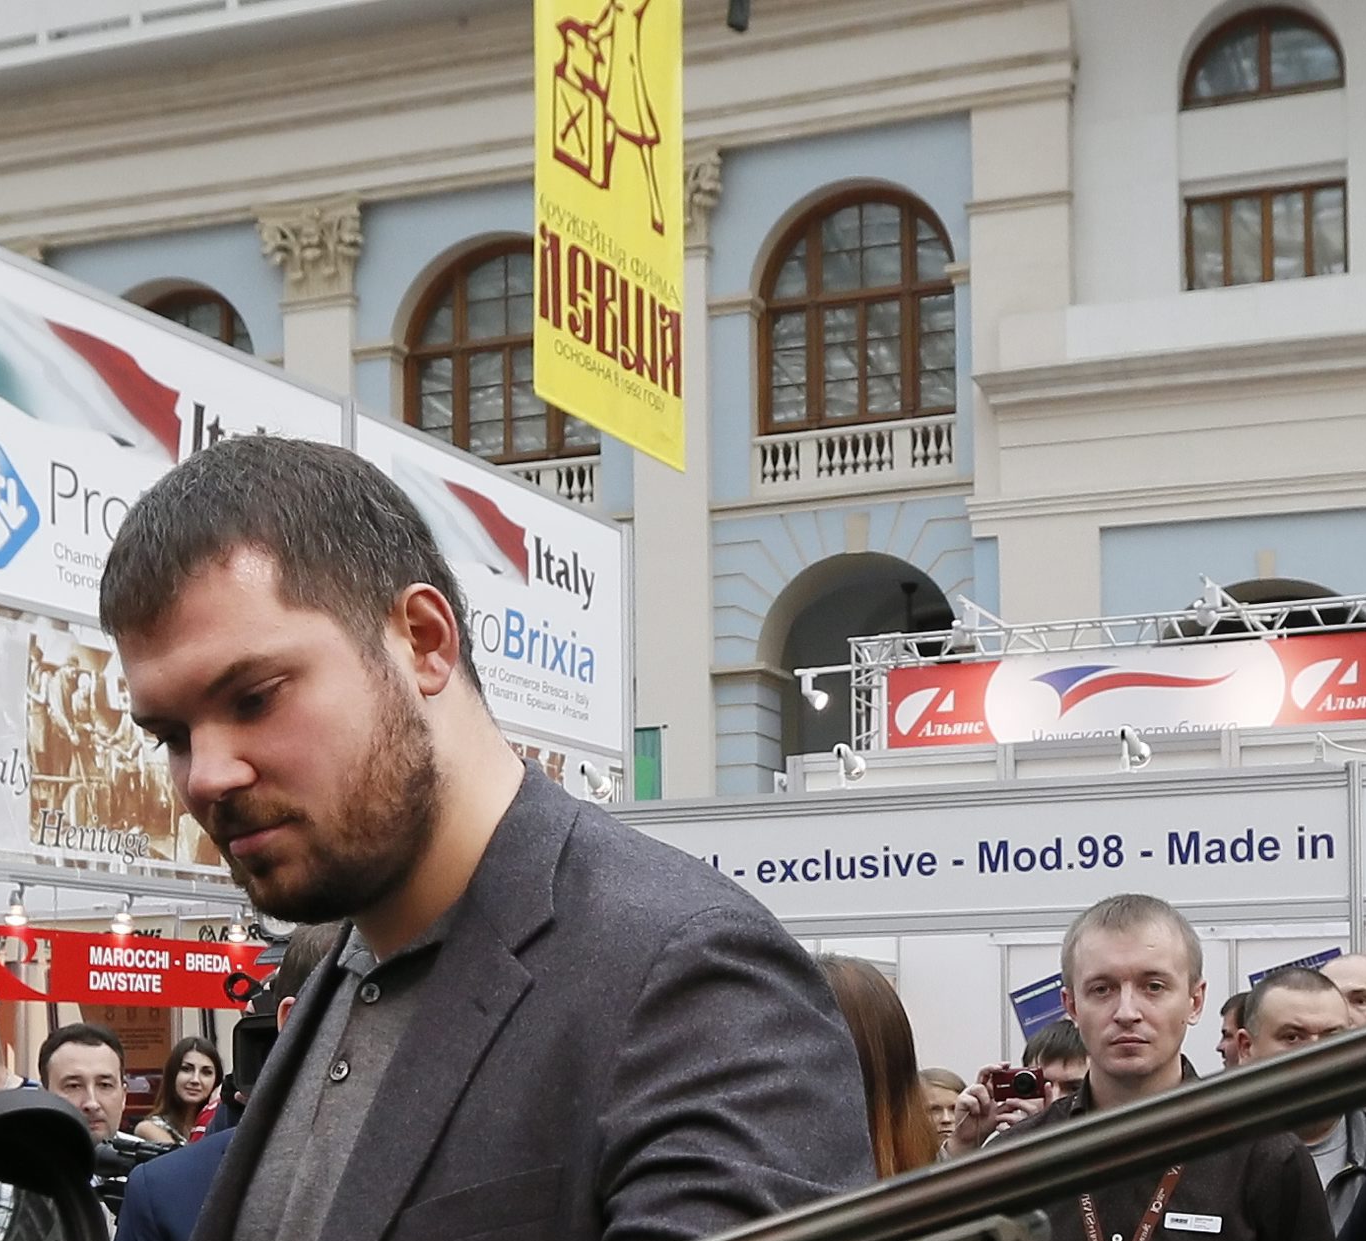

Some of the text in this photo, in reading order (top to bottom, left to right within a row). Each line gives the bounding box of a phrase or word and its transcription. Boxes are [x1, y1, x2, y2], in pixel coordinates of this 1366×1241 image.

[539, 221, 682, 399] ЛЕВША
[554, 339, 612, 383] ОСНОВАНА
[533, 535, 595, 611] Italy
[469, 607, 595, 684] roBrixia
[498, 668, 541, 692] Commerce
[541, 680, 569, 700] Brescia
[917, 718, 985, 739] Альянс
[37, 808, 151, 864] Heritage
[755, 845, 938, 884] exclusive
[977, 834, 1124, 874] Mod.98
[1167, 828, 1281, 866] Made
[1297, 825, 1334, 860] in
[89, 944, 170, 971] MAROCCHI
[184, 952, 232, 974] BREDA
[89, 970, 162, 994] DAYSTATE
